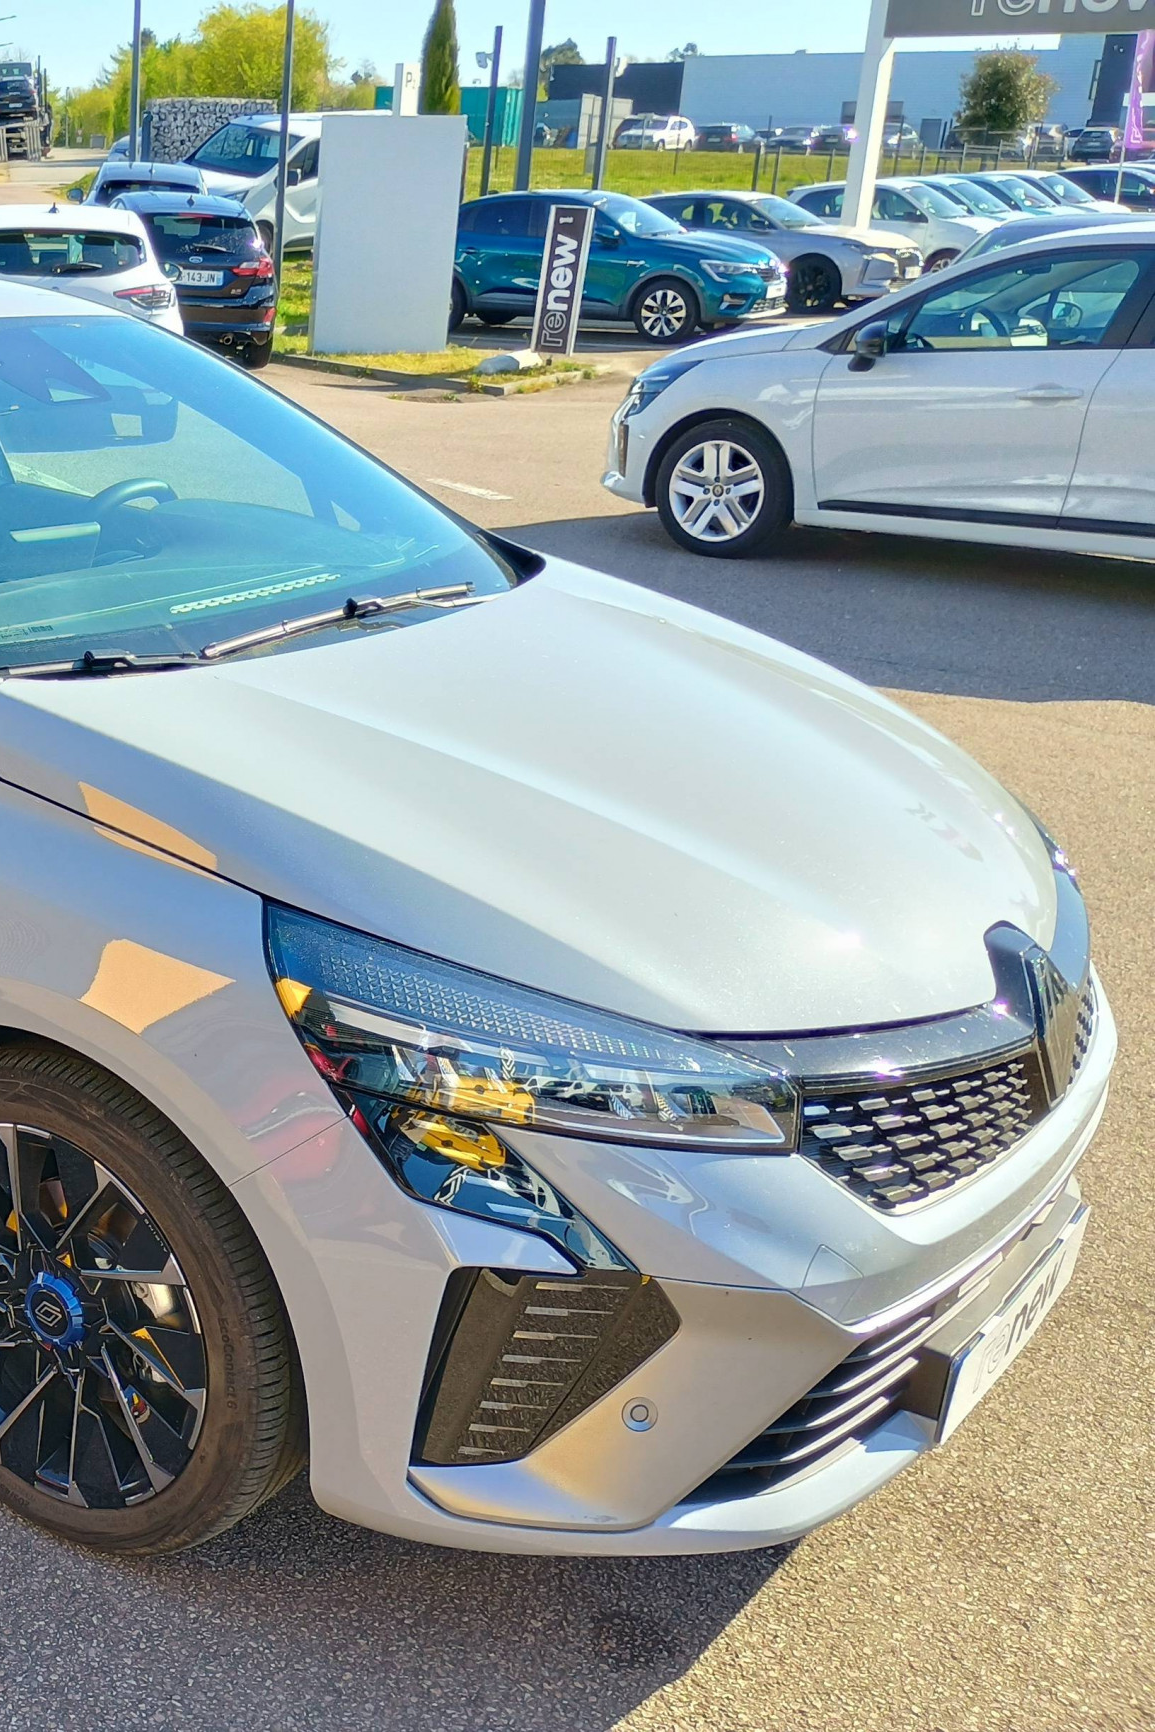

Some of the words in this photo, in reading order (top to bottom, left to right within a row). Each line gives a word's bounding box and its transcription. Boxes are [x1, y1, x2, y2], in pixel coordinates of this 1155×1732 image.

[540, 233, 579, 347] renew
[216, 1317, 237, 1398] EcoContact
[972, 1249, 1067, 1394] renew
[226, 1400, 238, 1410] 6
